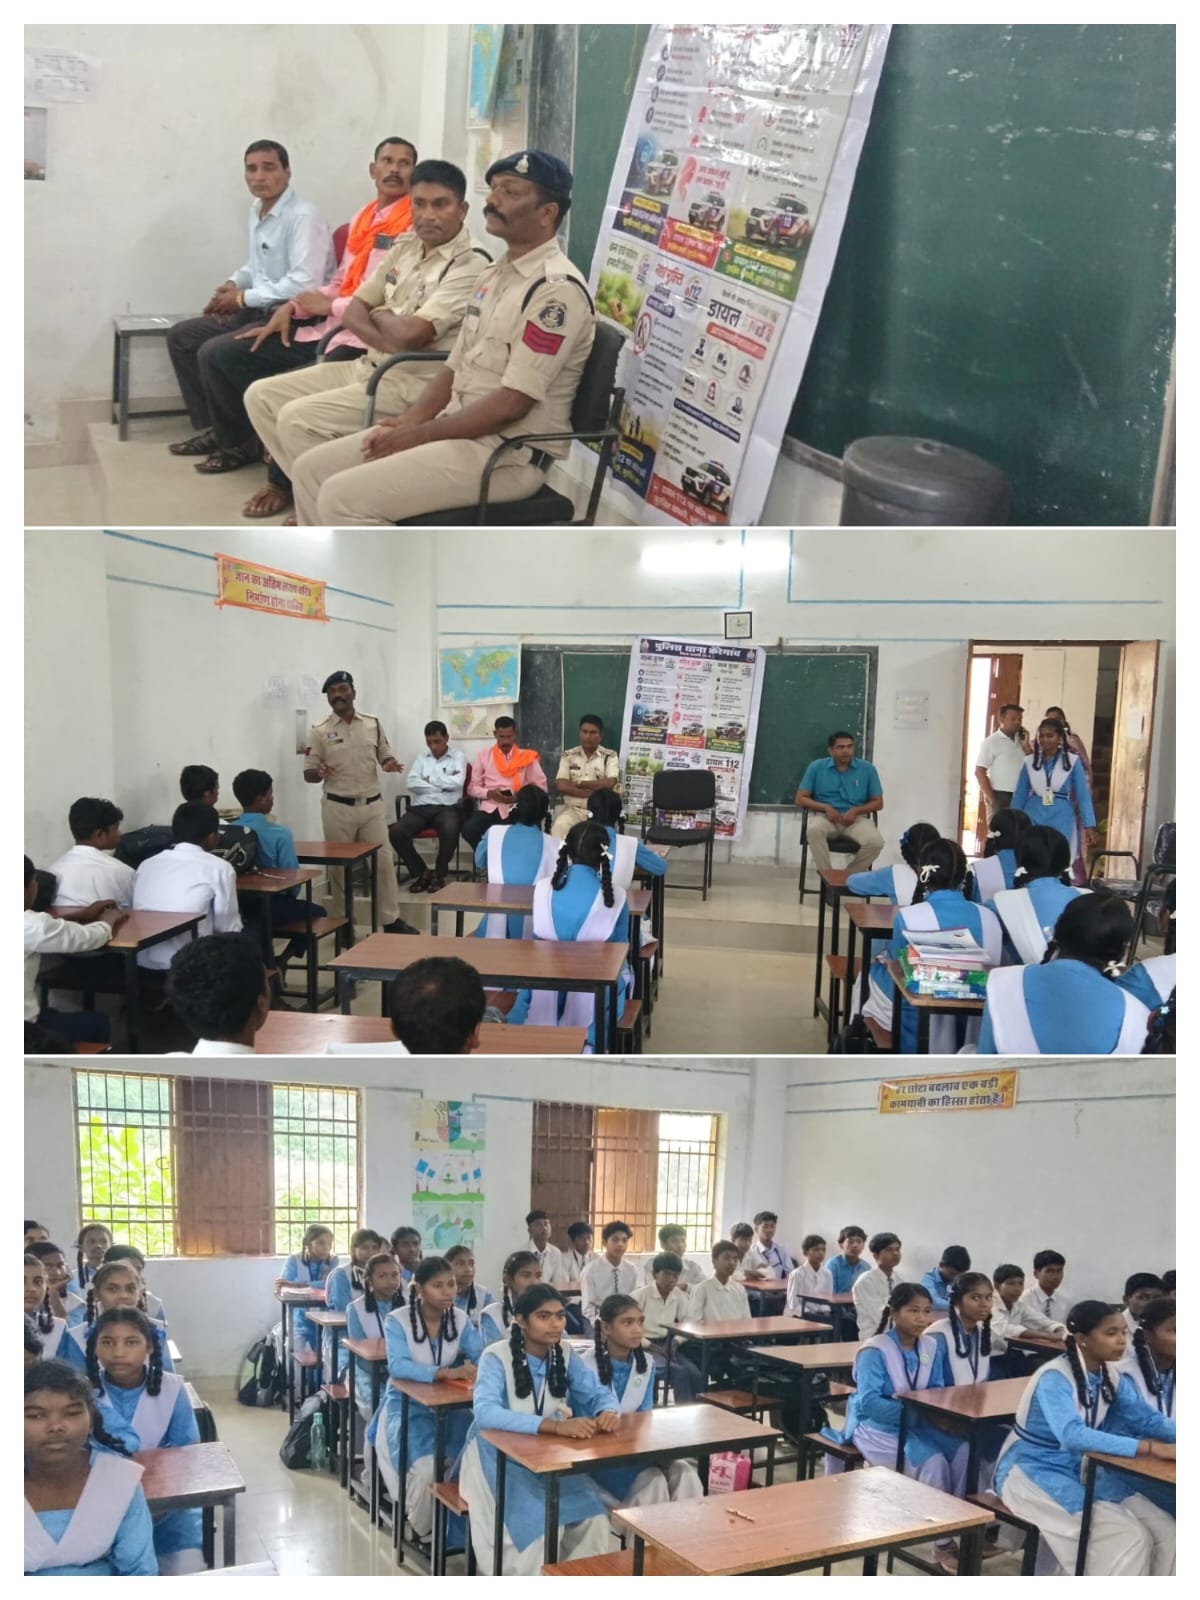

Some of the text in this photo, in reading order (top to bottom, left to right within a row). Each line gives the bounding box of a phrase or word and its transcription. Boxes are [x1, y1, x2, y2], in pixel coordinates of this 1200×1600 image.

[706, 299, 742, 327] डायल
[655, 641, 682, 654] पुलिस
[684, 645, 706, 654] थाना
[726, 759, 739, 768] 112
[928, 1081, 960, 1092] बदलाव
[961, 1081, 978, 1091] एक
[889, 1096, 925, 1109] कामयाबी
[927, 1097, 940, 1107] का
[940, 1094, 967, 1106] हिस्सा
[968, 1092, 990, 1105] होता
